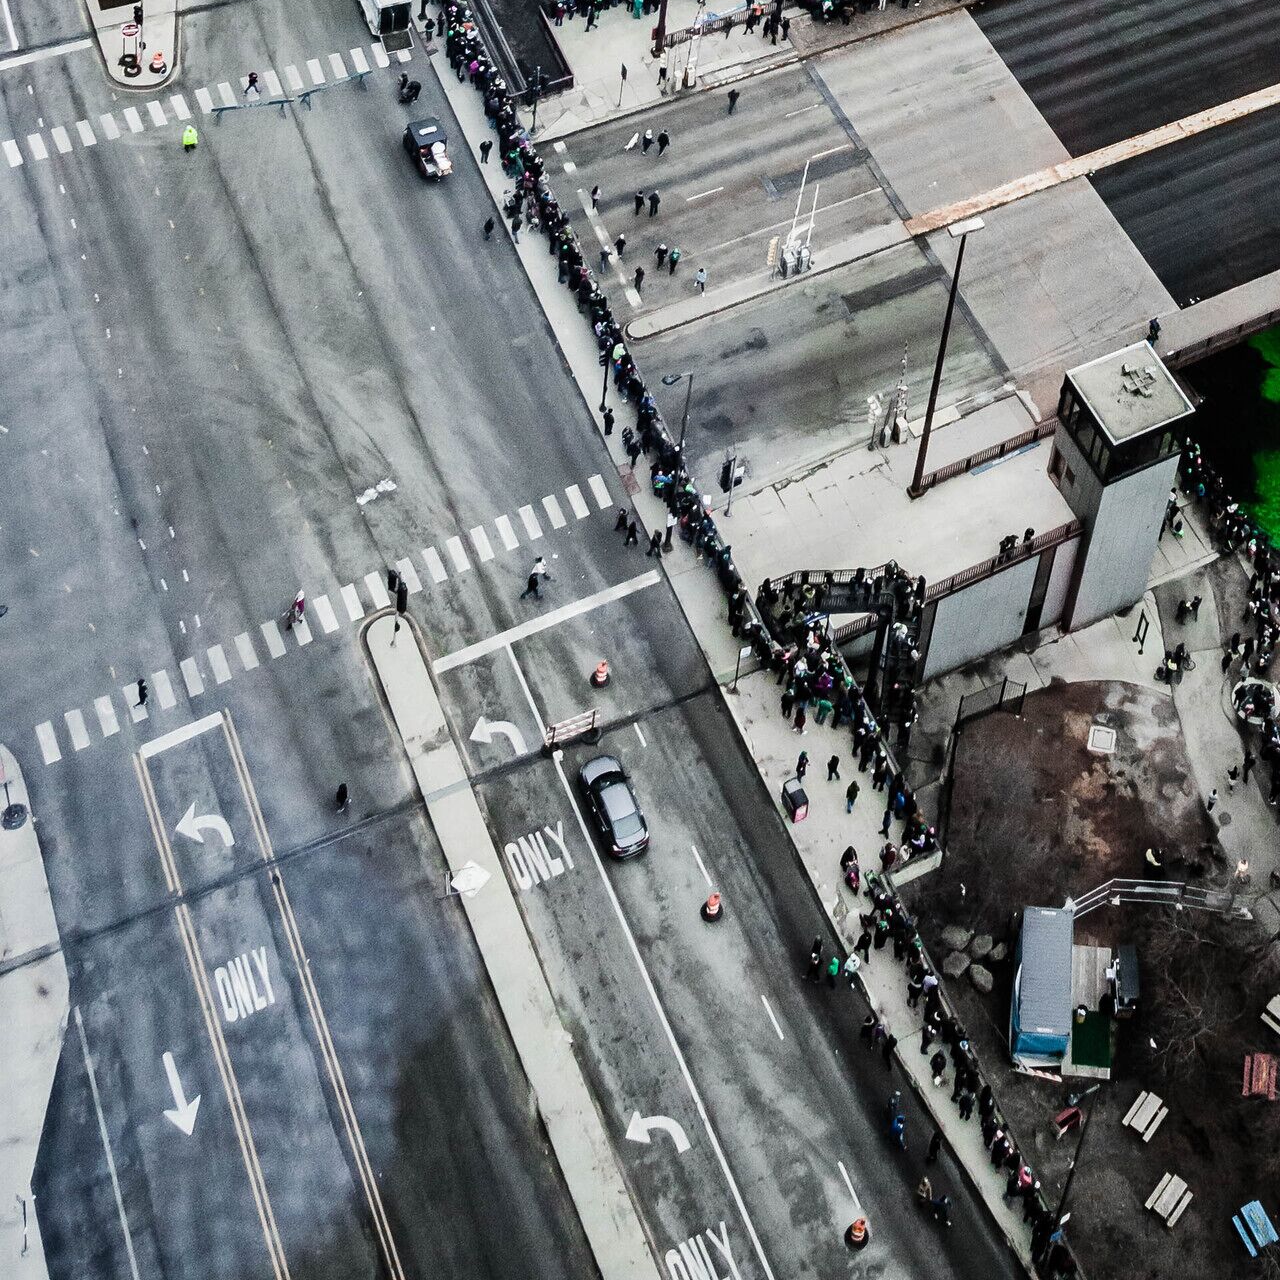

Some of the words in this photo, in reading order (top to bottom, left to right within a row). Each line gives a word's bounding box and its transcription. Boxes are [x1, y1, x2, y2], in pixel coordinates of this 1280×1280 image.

[505, 821, 574, 890] ONLY
[214, 946, 275, 1022] ONLY
[665, 1221, 742, 1280] ONLY
